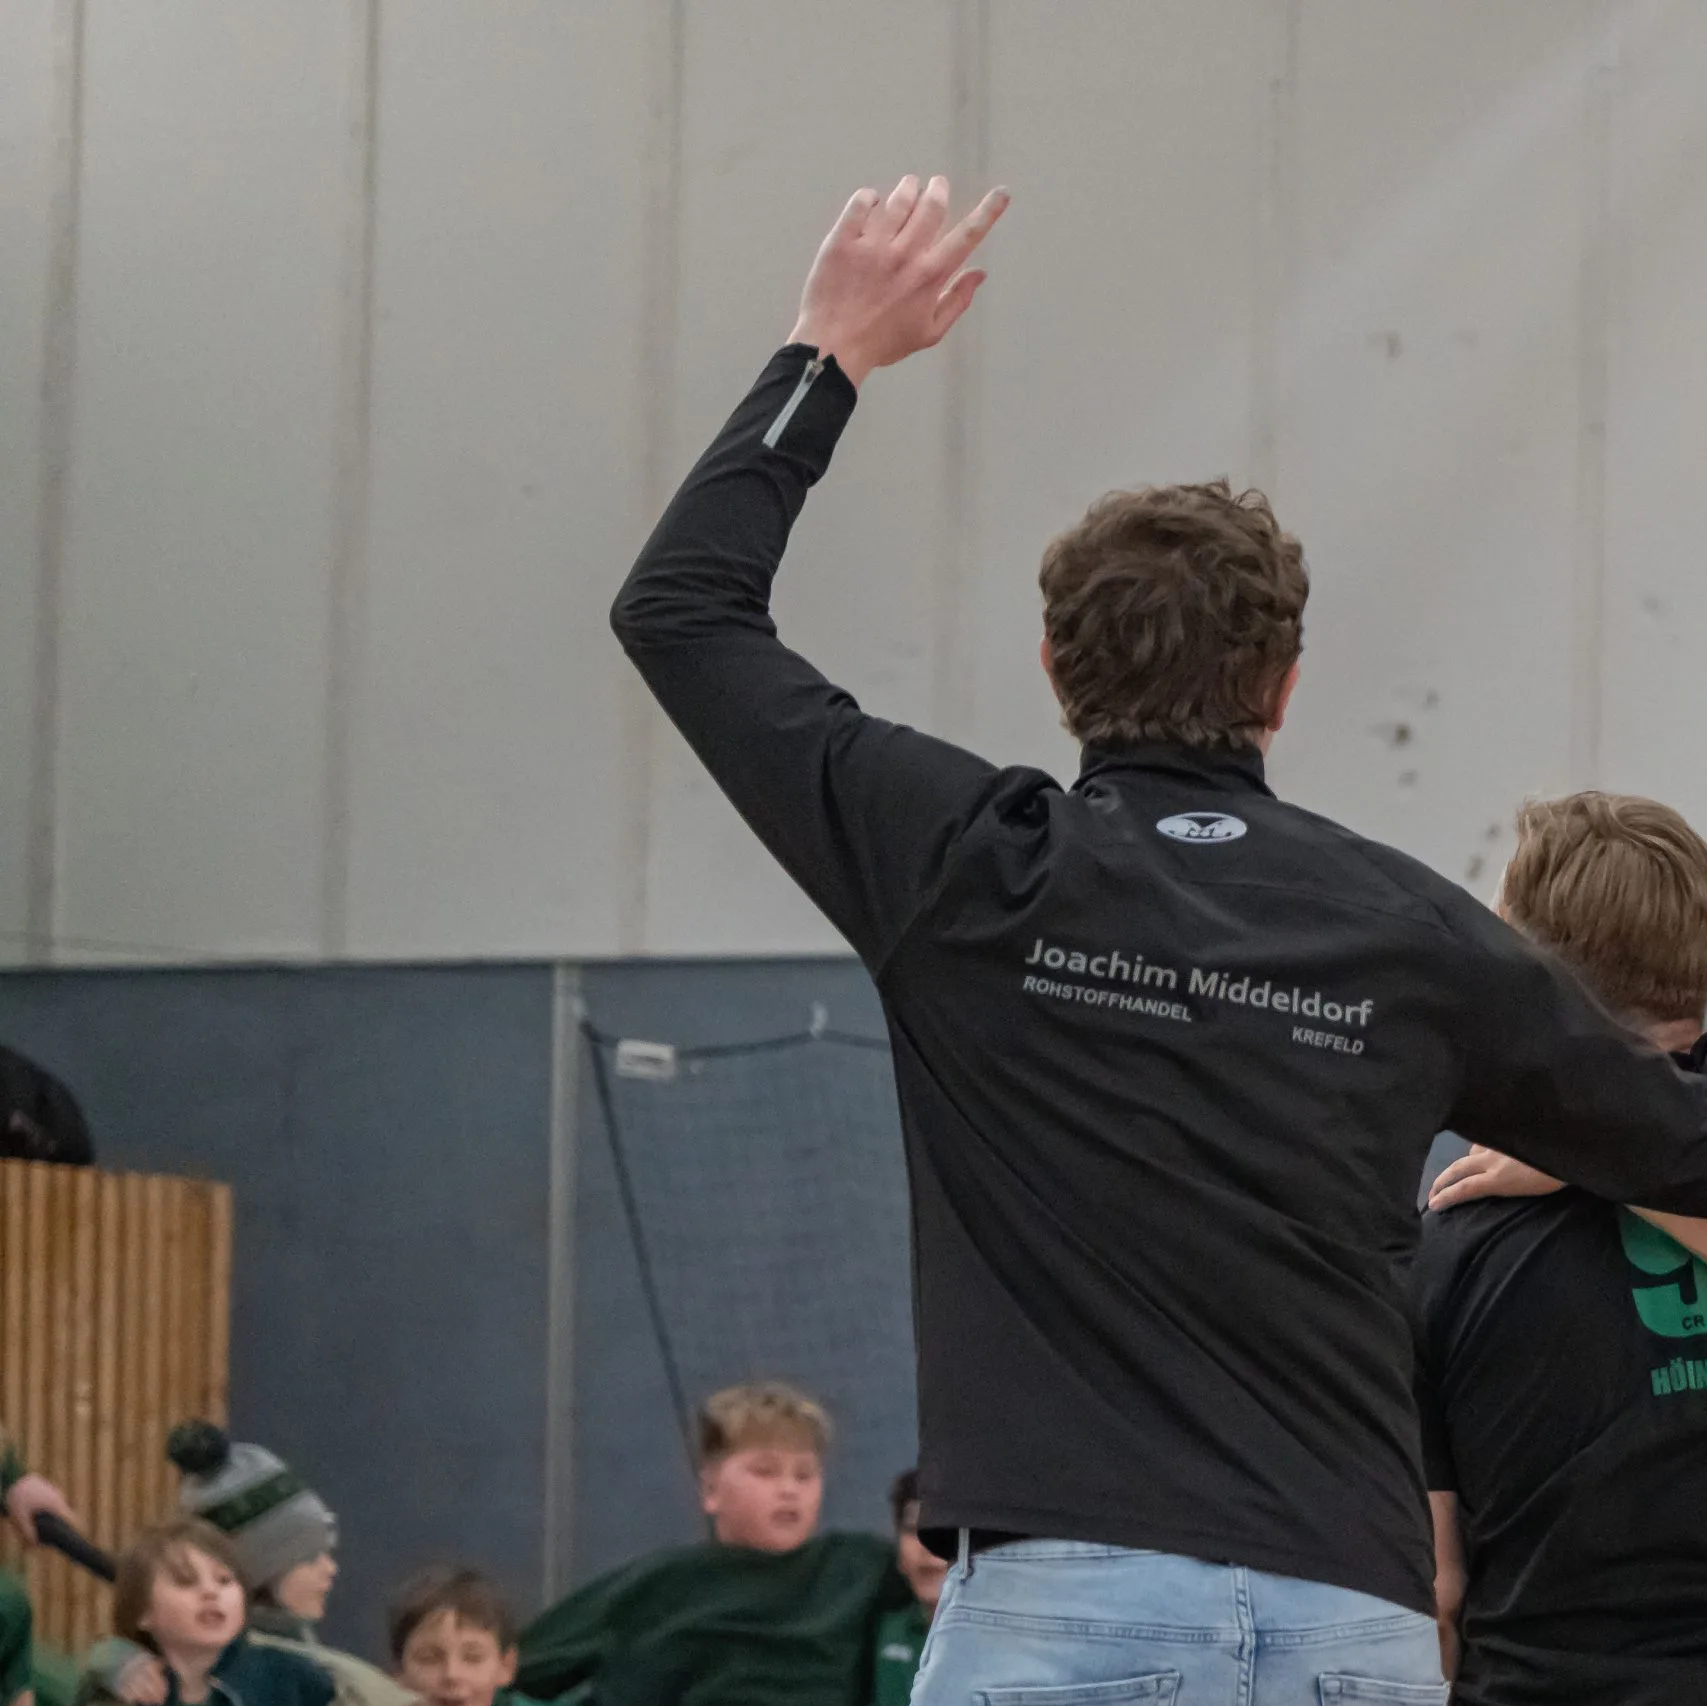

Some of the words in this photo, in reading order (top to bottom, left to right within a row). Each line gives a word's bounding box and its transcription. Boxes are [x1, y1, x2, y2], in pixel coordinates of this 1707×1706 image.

[1023, 976, 1192, 1023] ROHSTOFFHANDEL
[1025, 938, 1178, 989] Joachim
[1188, 967, 1374, 1026] Middeldorf
[1292, 1025, 1364, 1056] KREFELD
